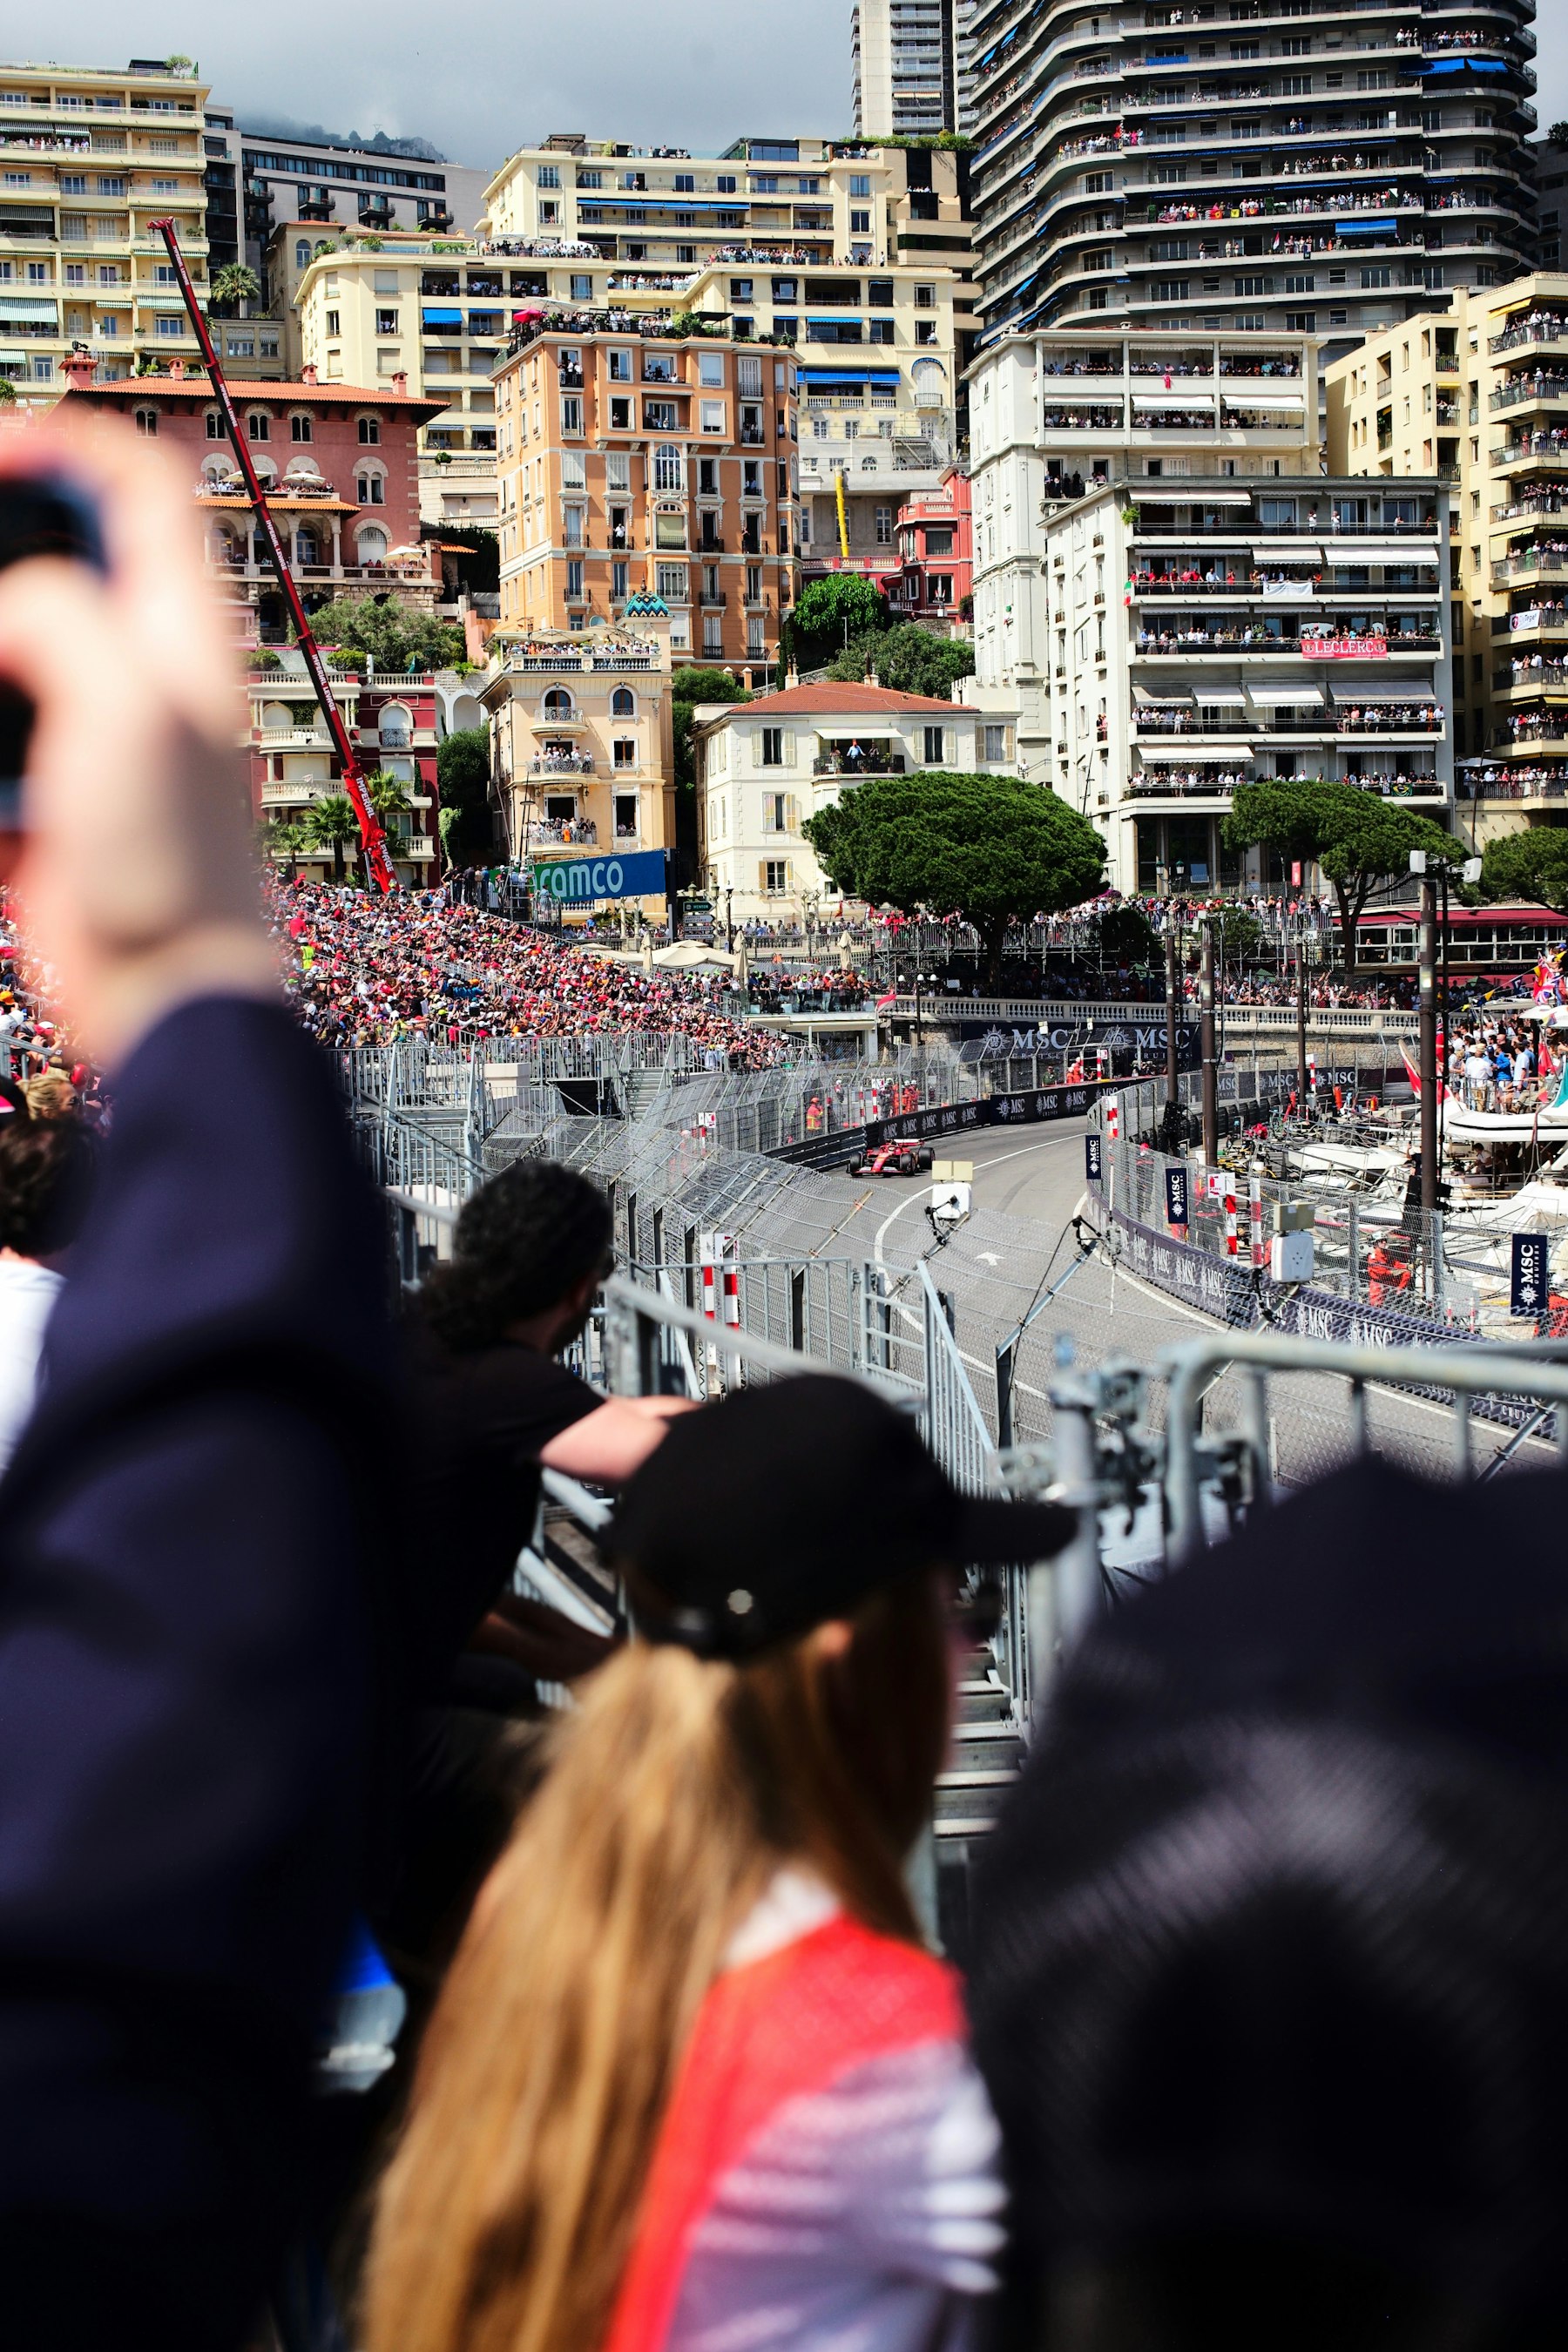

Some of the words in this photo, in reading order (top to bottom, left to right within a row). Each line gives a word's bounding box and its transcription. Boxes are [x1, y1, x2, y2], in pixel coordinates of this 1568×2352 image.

[266, 519, 280, 549] IMPERIAL
[275, 548, 288, 571] LEVAGE
[1315, 640, 1374, 653] LECLERC
[311, 653, 328, 686] IMPERIAL
[322, 686, 337, 713] LEVAGE
[355, 776, 375, 819] IMPERIAL
[377, 839, 395, 873] LEVAGE
[532, 861, 624, 898] ramco
[1011, 1029, 1068, 1049] MSC
[1134, 1029, 1190, 1049] MSC
[1268, 1074, 1294, 1088] MSC
[1328, 1071, 1355, 1085] MSC
[1010, 1098, 1025, 1113] MSC
[1043, 1094, 1058, 1110] MSC
[1072, 1091, 1087, 1105] MSC
[926, 1114, 936, 1128] MSC
[946, 1111, 956, 1125] MSC
[966, 1106, 977, 1120] MSC
[888, 1123, 898, 1138] MSC
[907, 1119, 917, 1132] MSC
[1172, 1175, 1180, 1202] MSC
[1158, 1247, 1169, 1274] MSC
[1521, 1244, 1533, 1284] MSC
[1182, 1258, 1196, 1287] MSC
[1207, 1267, 1223, 1298] MSC
[1308, 1307, 1333, 1342] MSC
[1363, 1320, 1393, 1350] MSC
